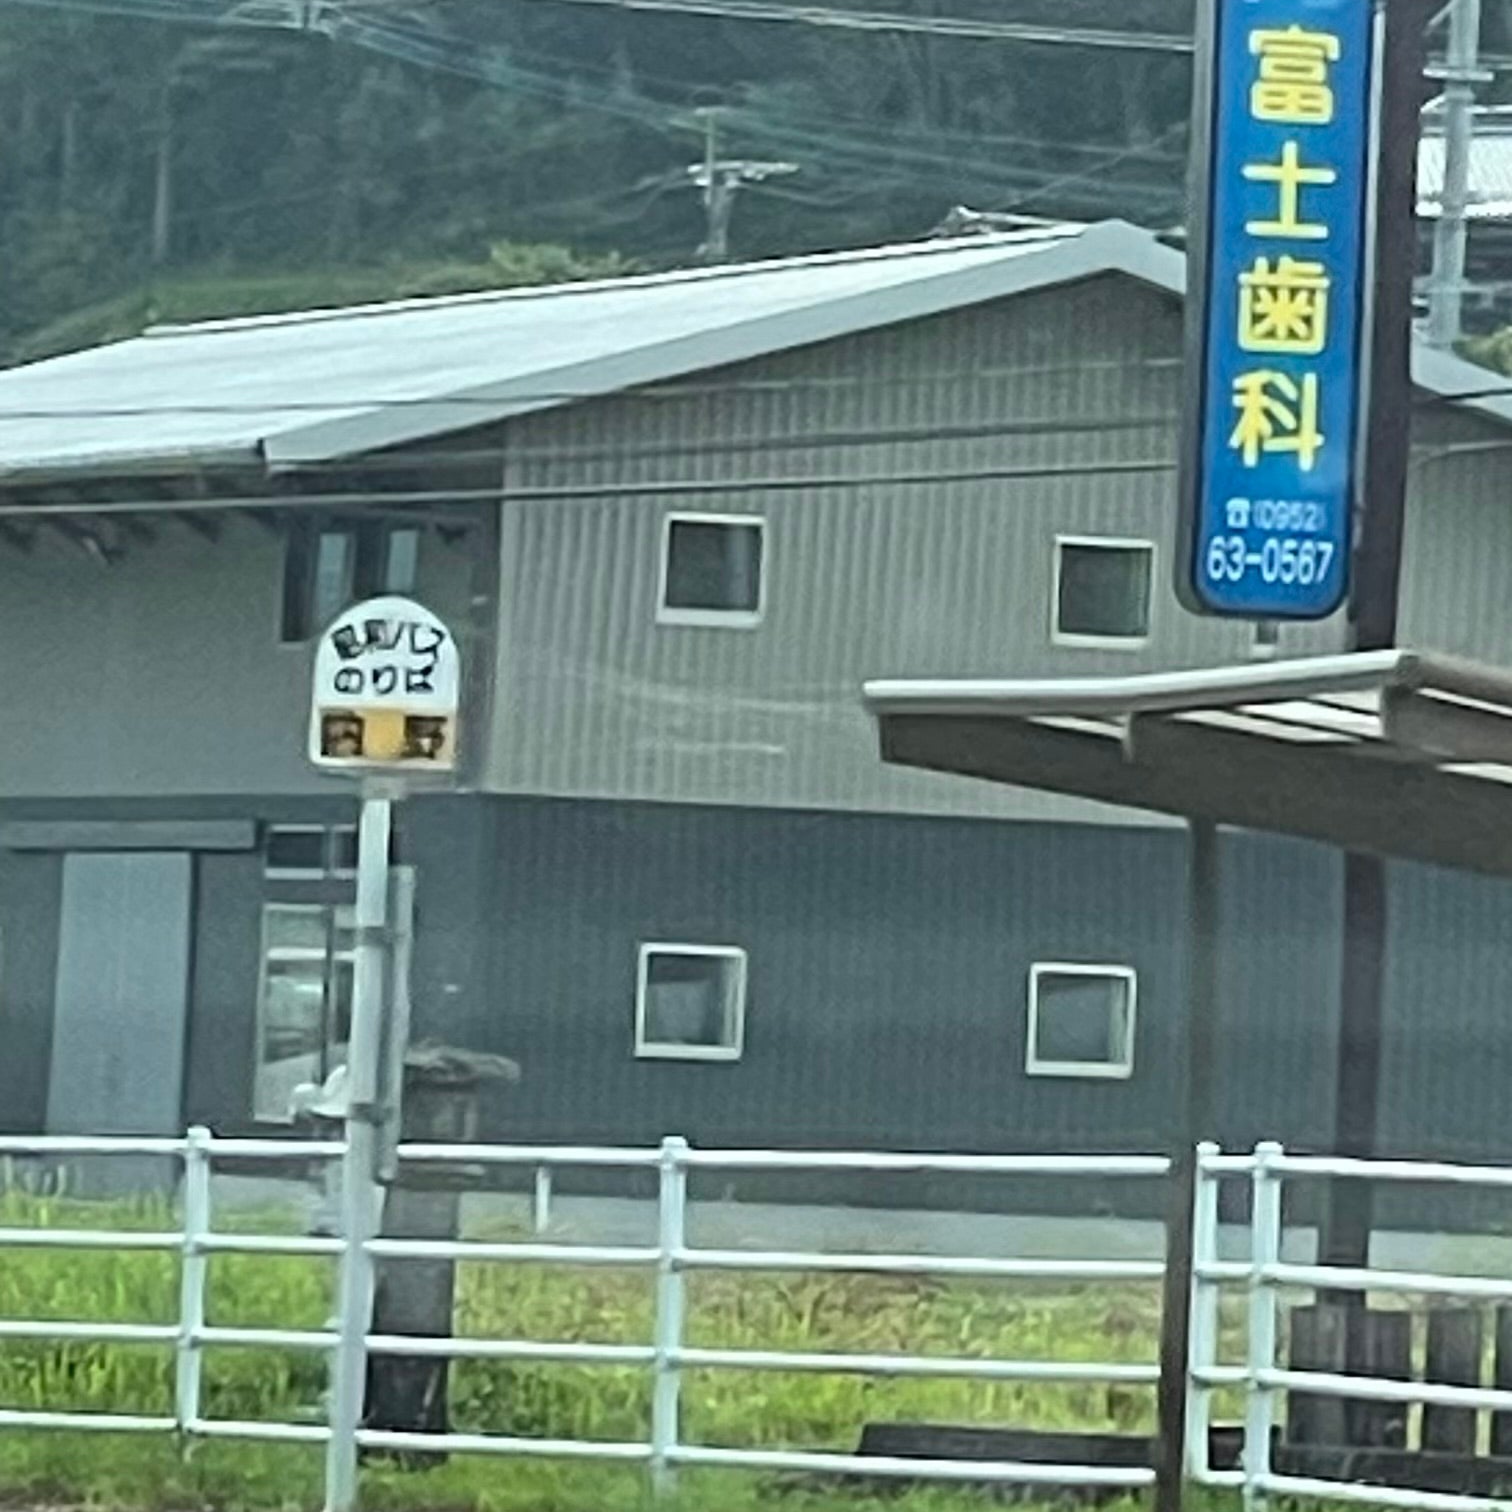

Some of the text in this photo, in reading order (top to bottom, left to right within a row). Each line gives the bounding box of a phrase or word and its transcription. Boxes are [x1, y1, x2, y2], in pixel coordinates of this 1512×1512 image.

[1229, 24, 1340, 471] 富士歯科
[1207, 535, 1334, 585] 63-0567
